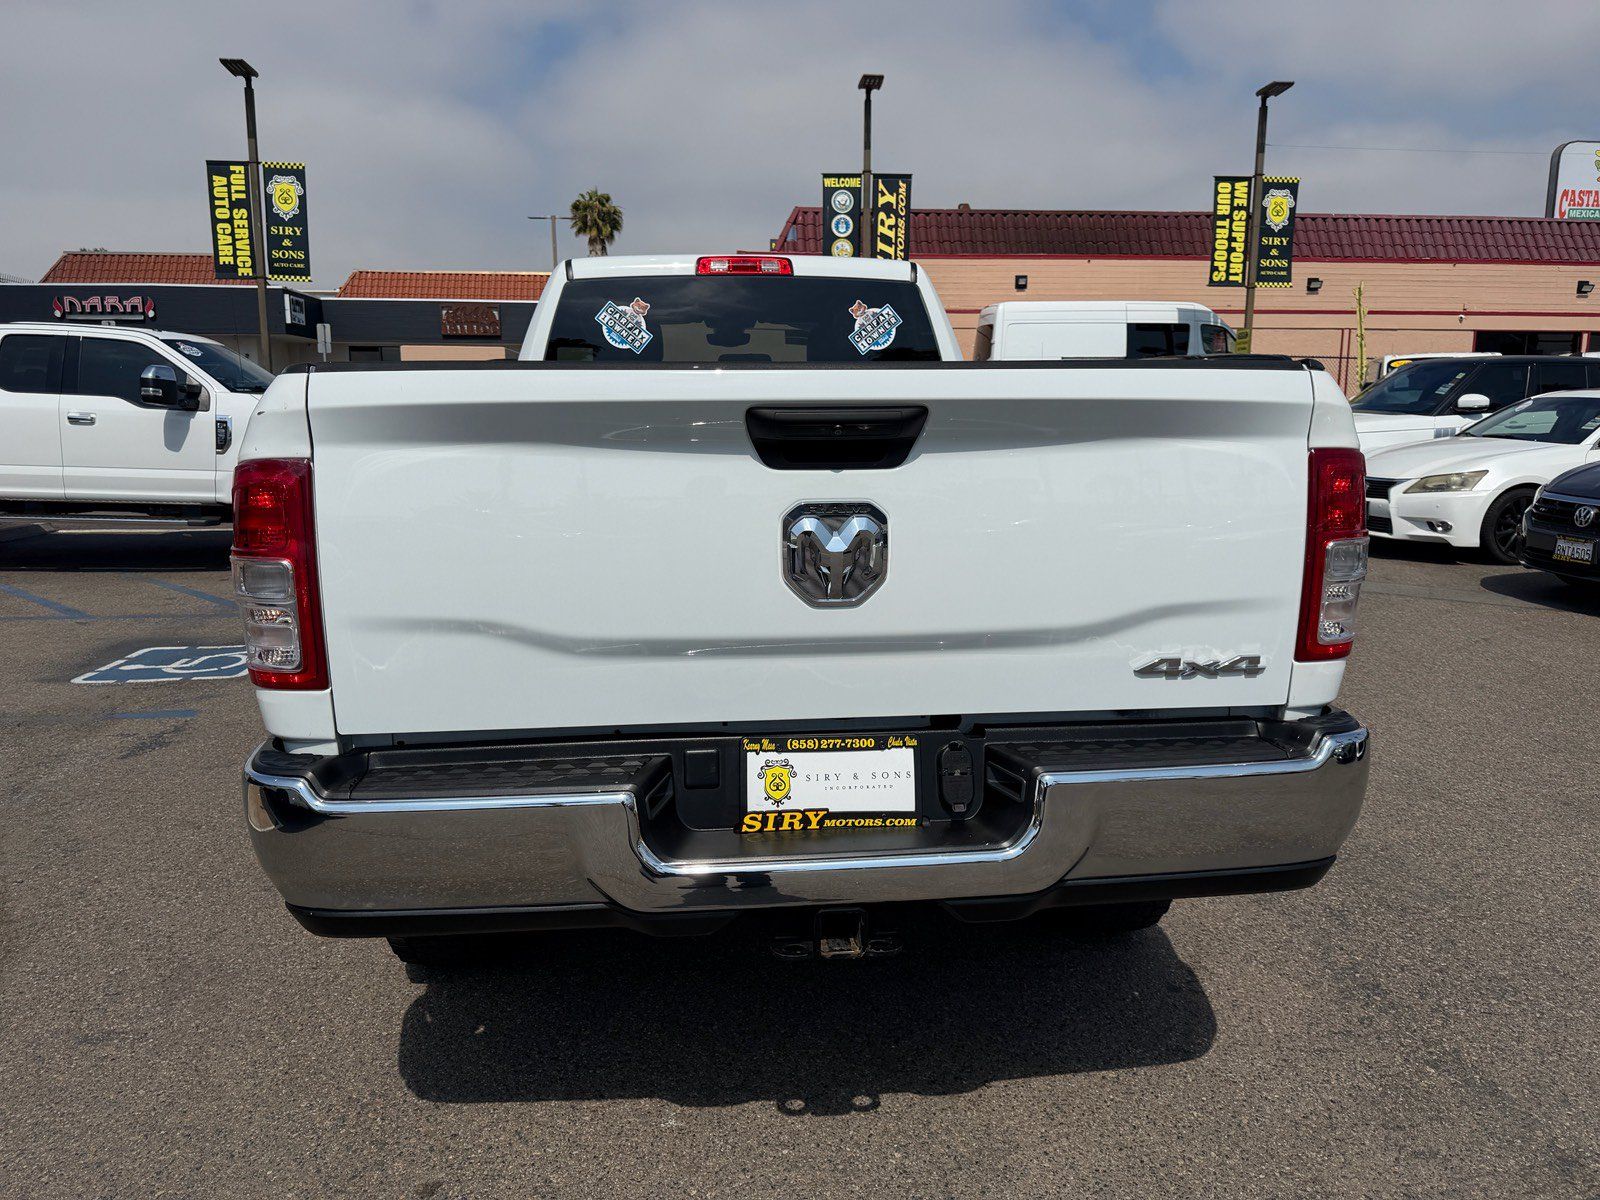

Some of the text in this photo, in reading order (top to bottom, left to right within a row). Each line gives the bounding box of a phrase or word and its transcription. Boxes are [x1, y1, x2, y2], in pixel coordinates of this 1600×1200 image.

[824, 178, 862, 188] WELCOME
[212, 175, 234, 265] AUTO CARE
[230, 166, 252, 276] FULL SERVICE
[877, 179, 896, 260] IRY
[270, 226, 302, 236] SIRY
[282, 238, 292, 246] &
[1212, 182, 1232, 282] OUR TROOPS
[1229, 182, 1248, 283] WE SUPPORT
[1261, 236, 1290, 246] SIRY
[272, 250, 305, 260] SONS
[1260, 258, 1288, 268] SONS
[64, 296, 143, 312] NARA
[607, 307, 646, 343] CARFAX
[608, 320, 641, 348] OWNER
[854, 311, 892, 342] CARFAX
[866, 316, 897, 344] OWNER
[787, 738, 875, 750] (858) 277-7300
[806, 771, 912, 782] SIRY & SONS
